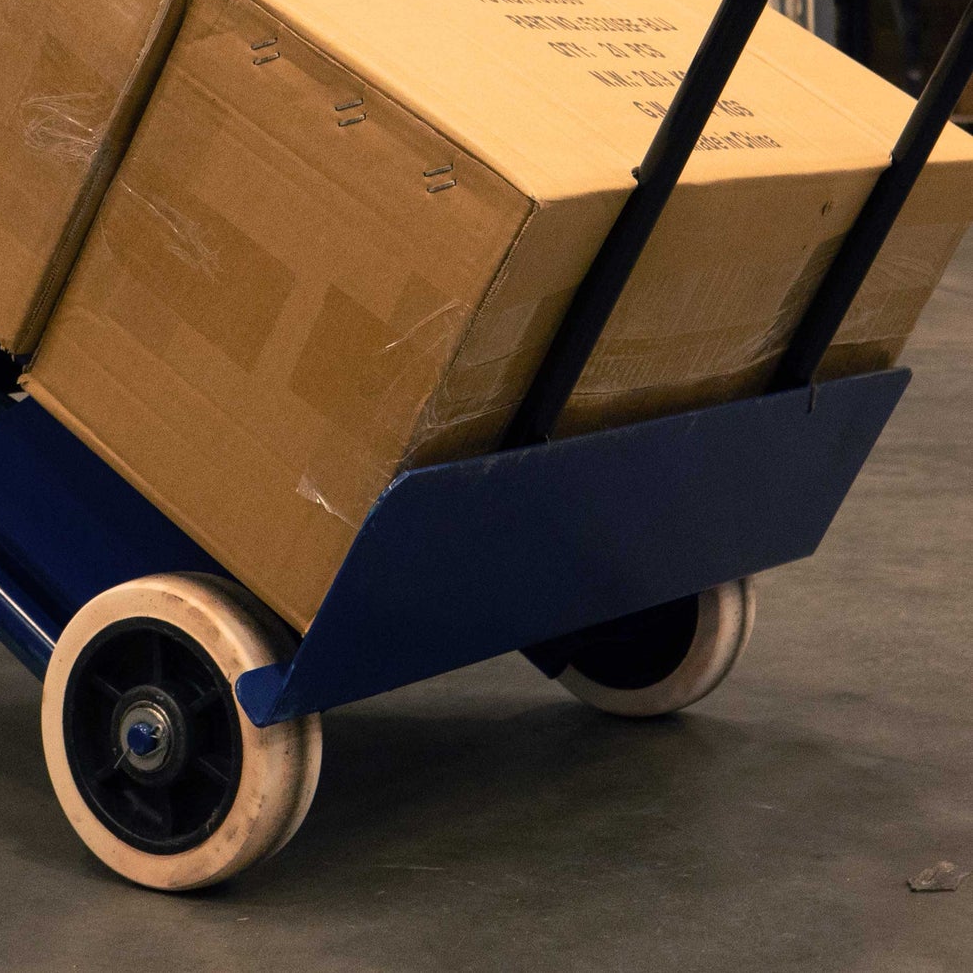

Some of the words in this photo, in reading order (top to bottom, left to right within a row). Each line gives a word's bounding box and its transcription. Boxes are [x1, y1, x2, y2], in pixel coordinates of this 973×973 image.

[504, 14, 557, 30] PART
[547, 42, 597, 58] QTY:
[597, 42, 630, 58] 20
[624, 42, 666, 58] PCS
[631, 70, 675, 87] 20.9
[729, 131, 782, 149] China
